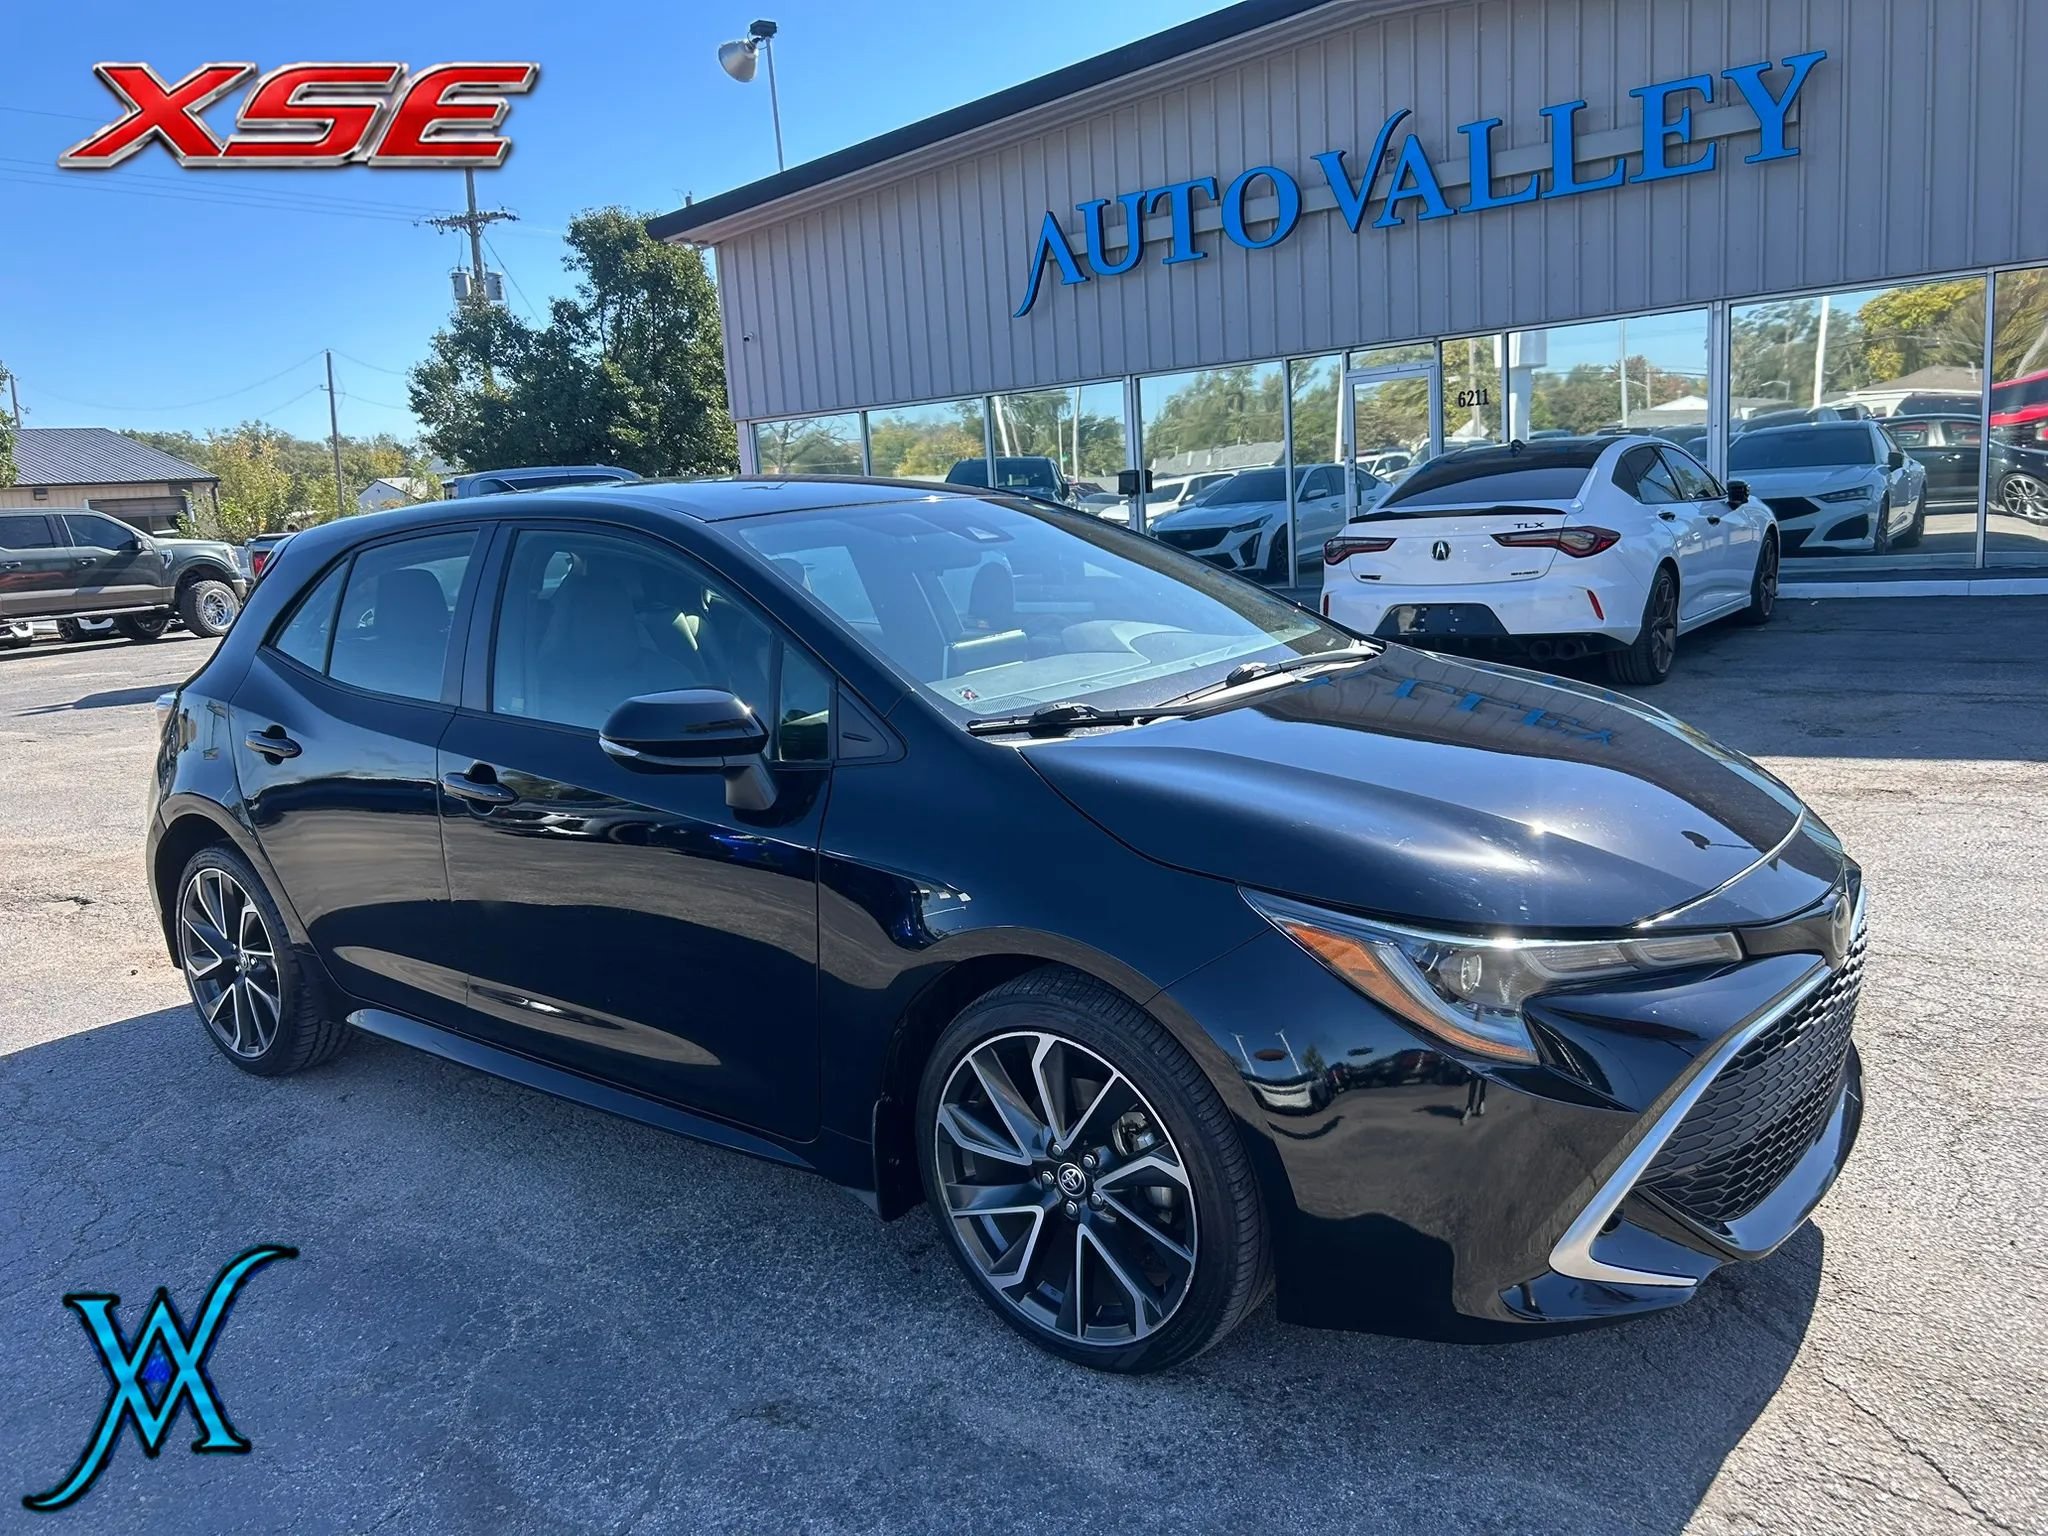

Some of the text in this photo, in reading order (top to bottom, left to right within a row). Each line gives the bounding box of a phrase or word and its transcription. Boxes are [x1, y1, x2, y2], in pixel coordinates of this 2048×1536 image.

[1014, 50, 1826, 319] AUTO VALLEY
[1458, 388, 1489, 407] 6211
[1513, 521, 1545, 529] TLX
